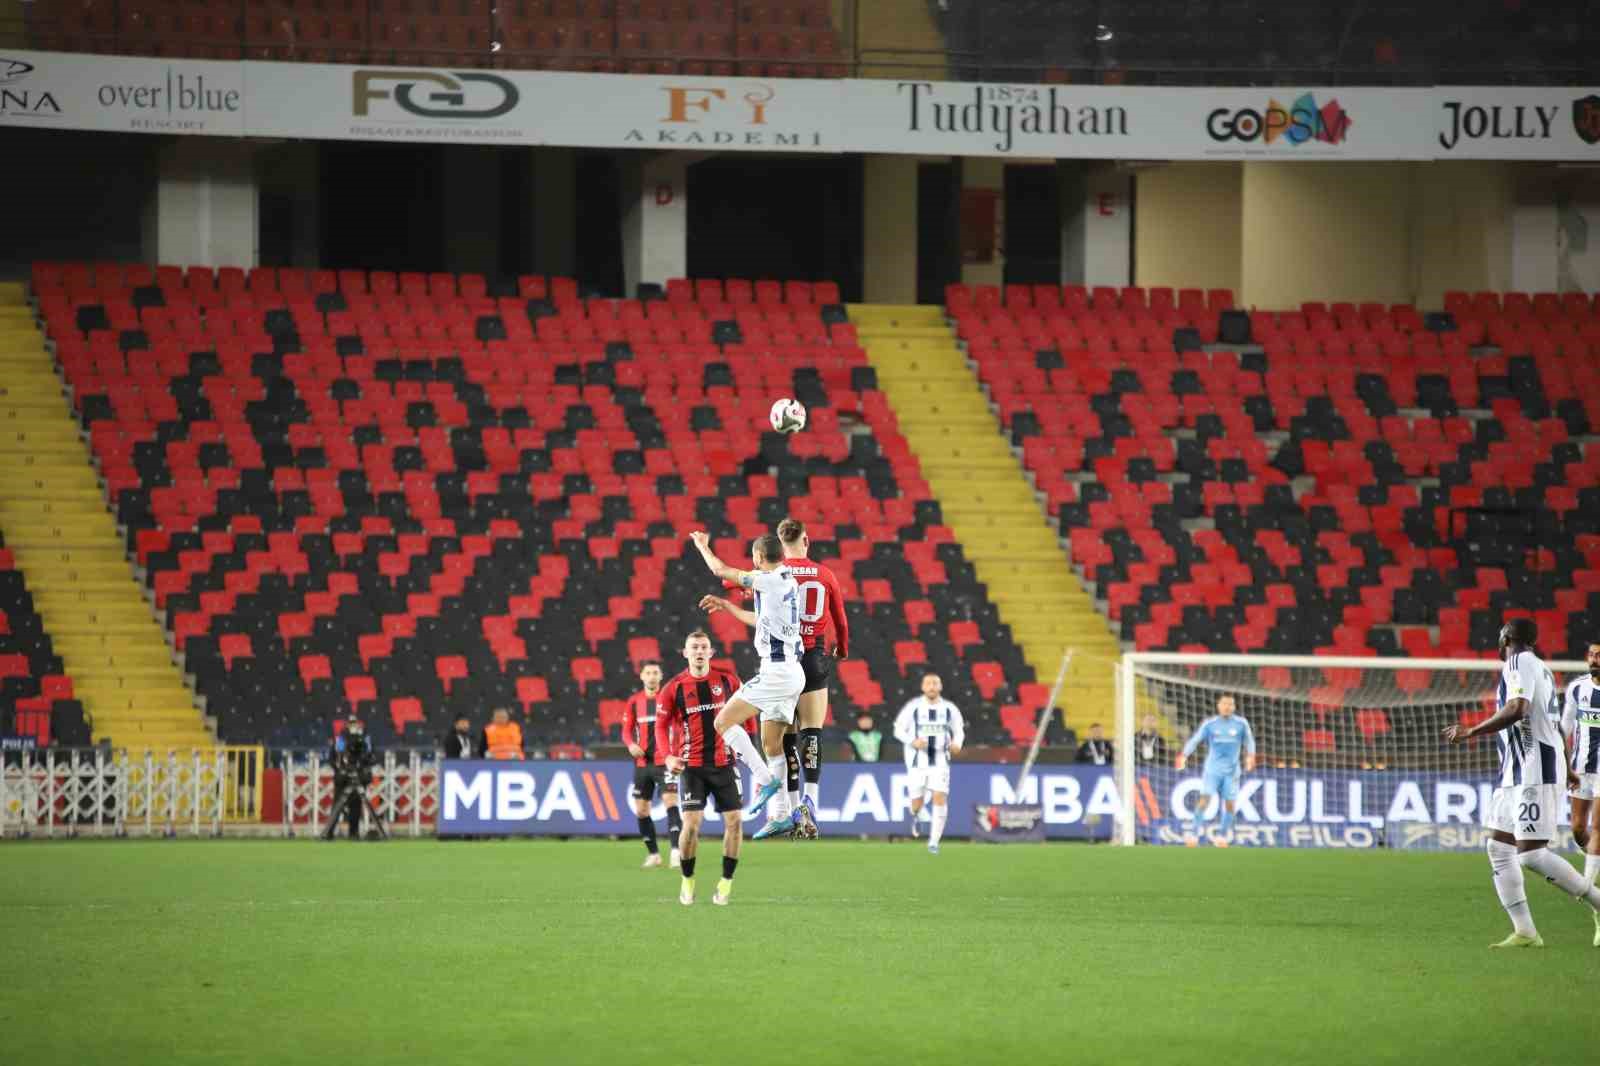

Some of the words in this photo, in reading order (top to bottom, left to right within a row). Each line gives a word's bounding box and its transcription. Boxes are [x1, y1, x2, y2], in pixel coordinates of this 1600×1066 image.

[988, 87, 1040, 102] 1874
[898, 82, 1129, 152] Tudyahan
[442, 769, 586, 821] MBA
[1518, 802, 1541, 822] 20
